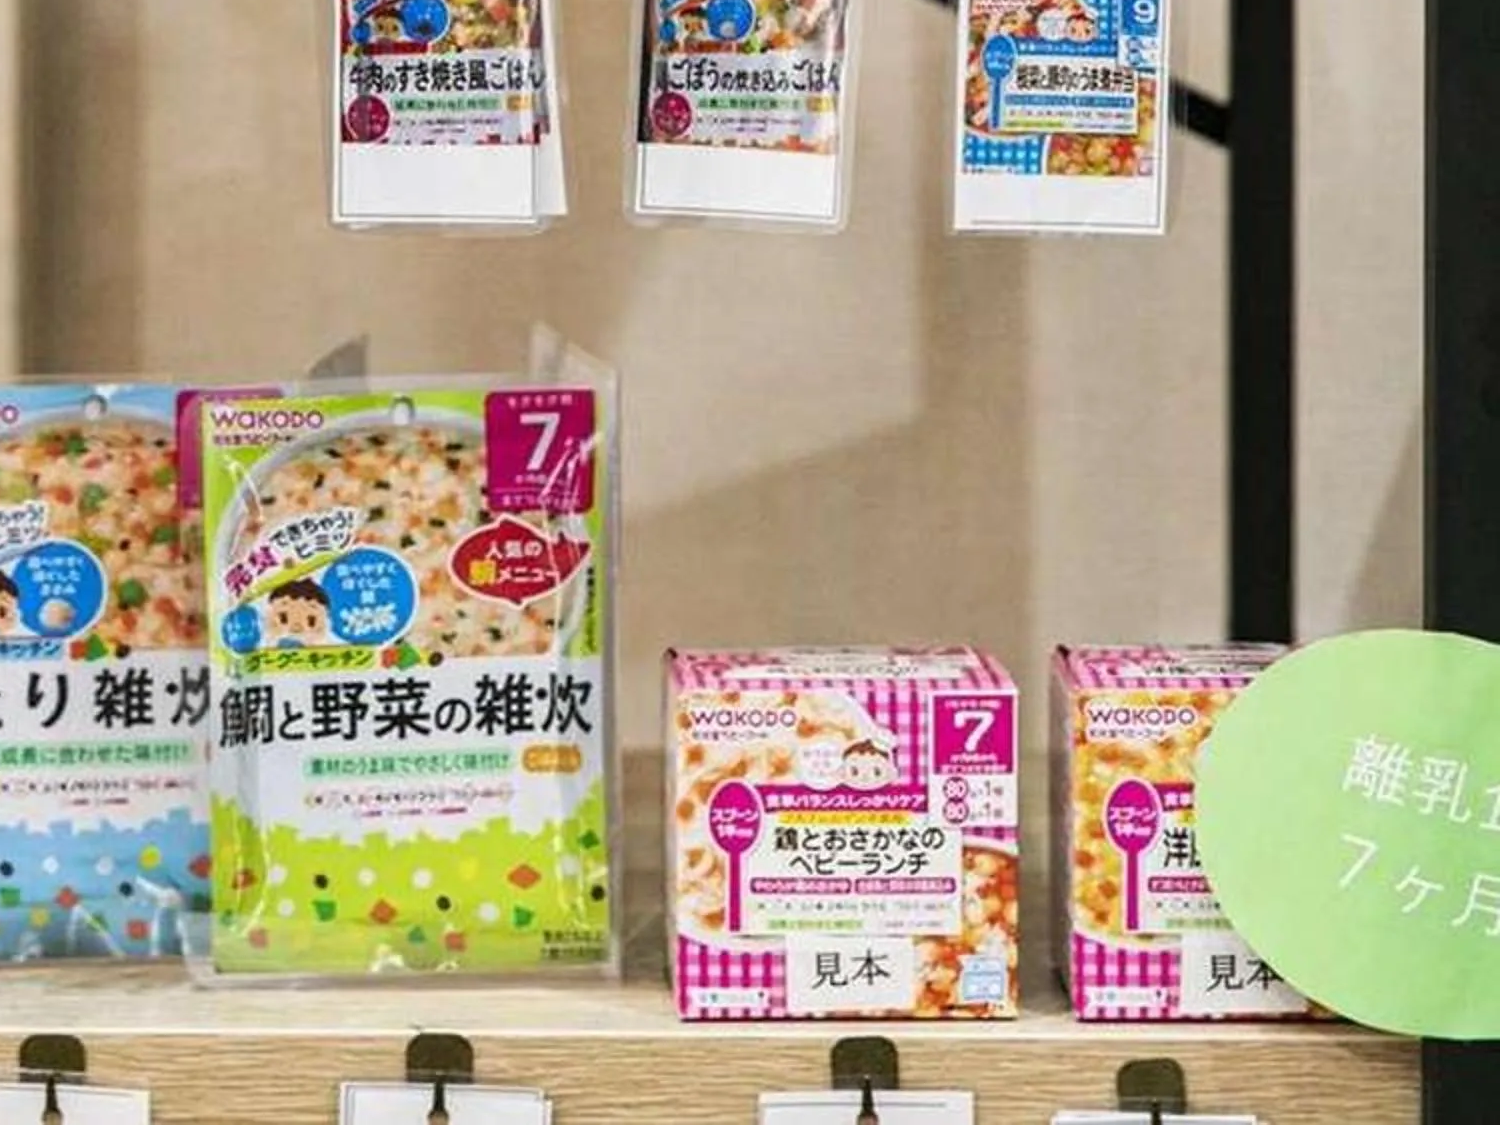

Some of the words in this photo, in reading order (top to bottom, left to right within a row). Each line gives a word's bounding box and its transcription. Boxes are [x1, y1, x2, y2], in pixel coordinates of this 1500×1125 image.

[520, 412, 561, 472] 7
[269, 511, 355, 549] できちゃう!
[295, 532, 357, 561] ヒミツ
[486, 542, 543, 560] 人気の
[219, 672, 594, 748] 鯛と野菜の雑炊
[953, 710, 996, 753] 7
[765, 793, 927, 810] 食事バランスしっかりケア
[774, 826, 947, 853] 鶏とおさかなの
[787, 852, 931, 876] ベビーランチ
[811, 948, 893, 991] 見本
[1206, 954, 1285, 993] 見本
